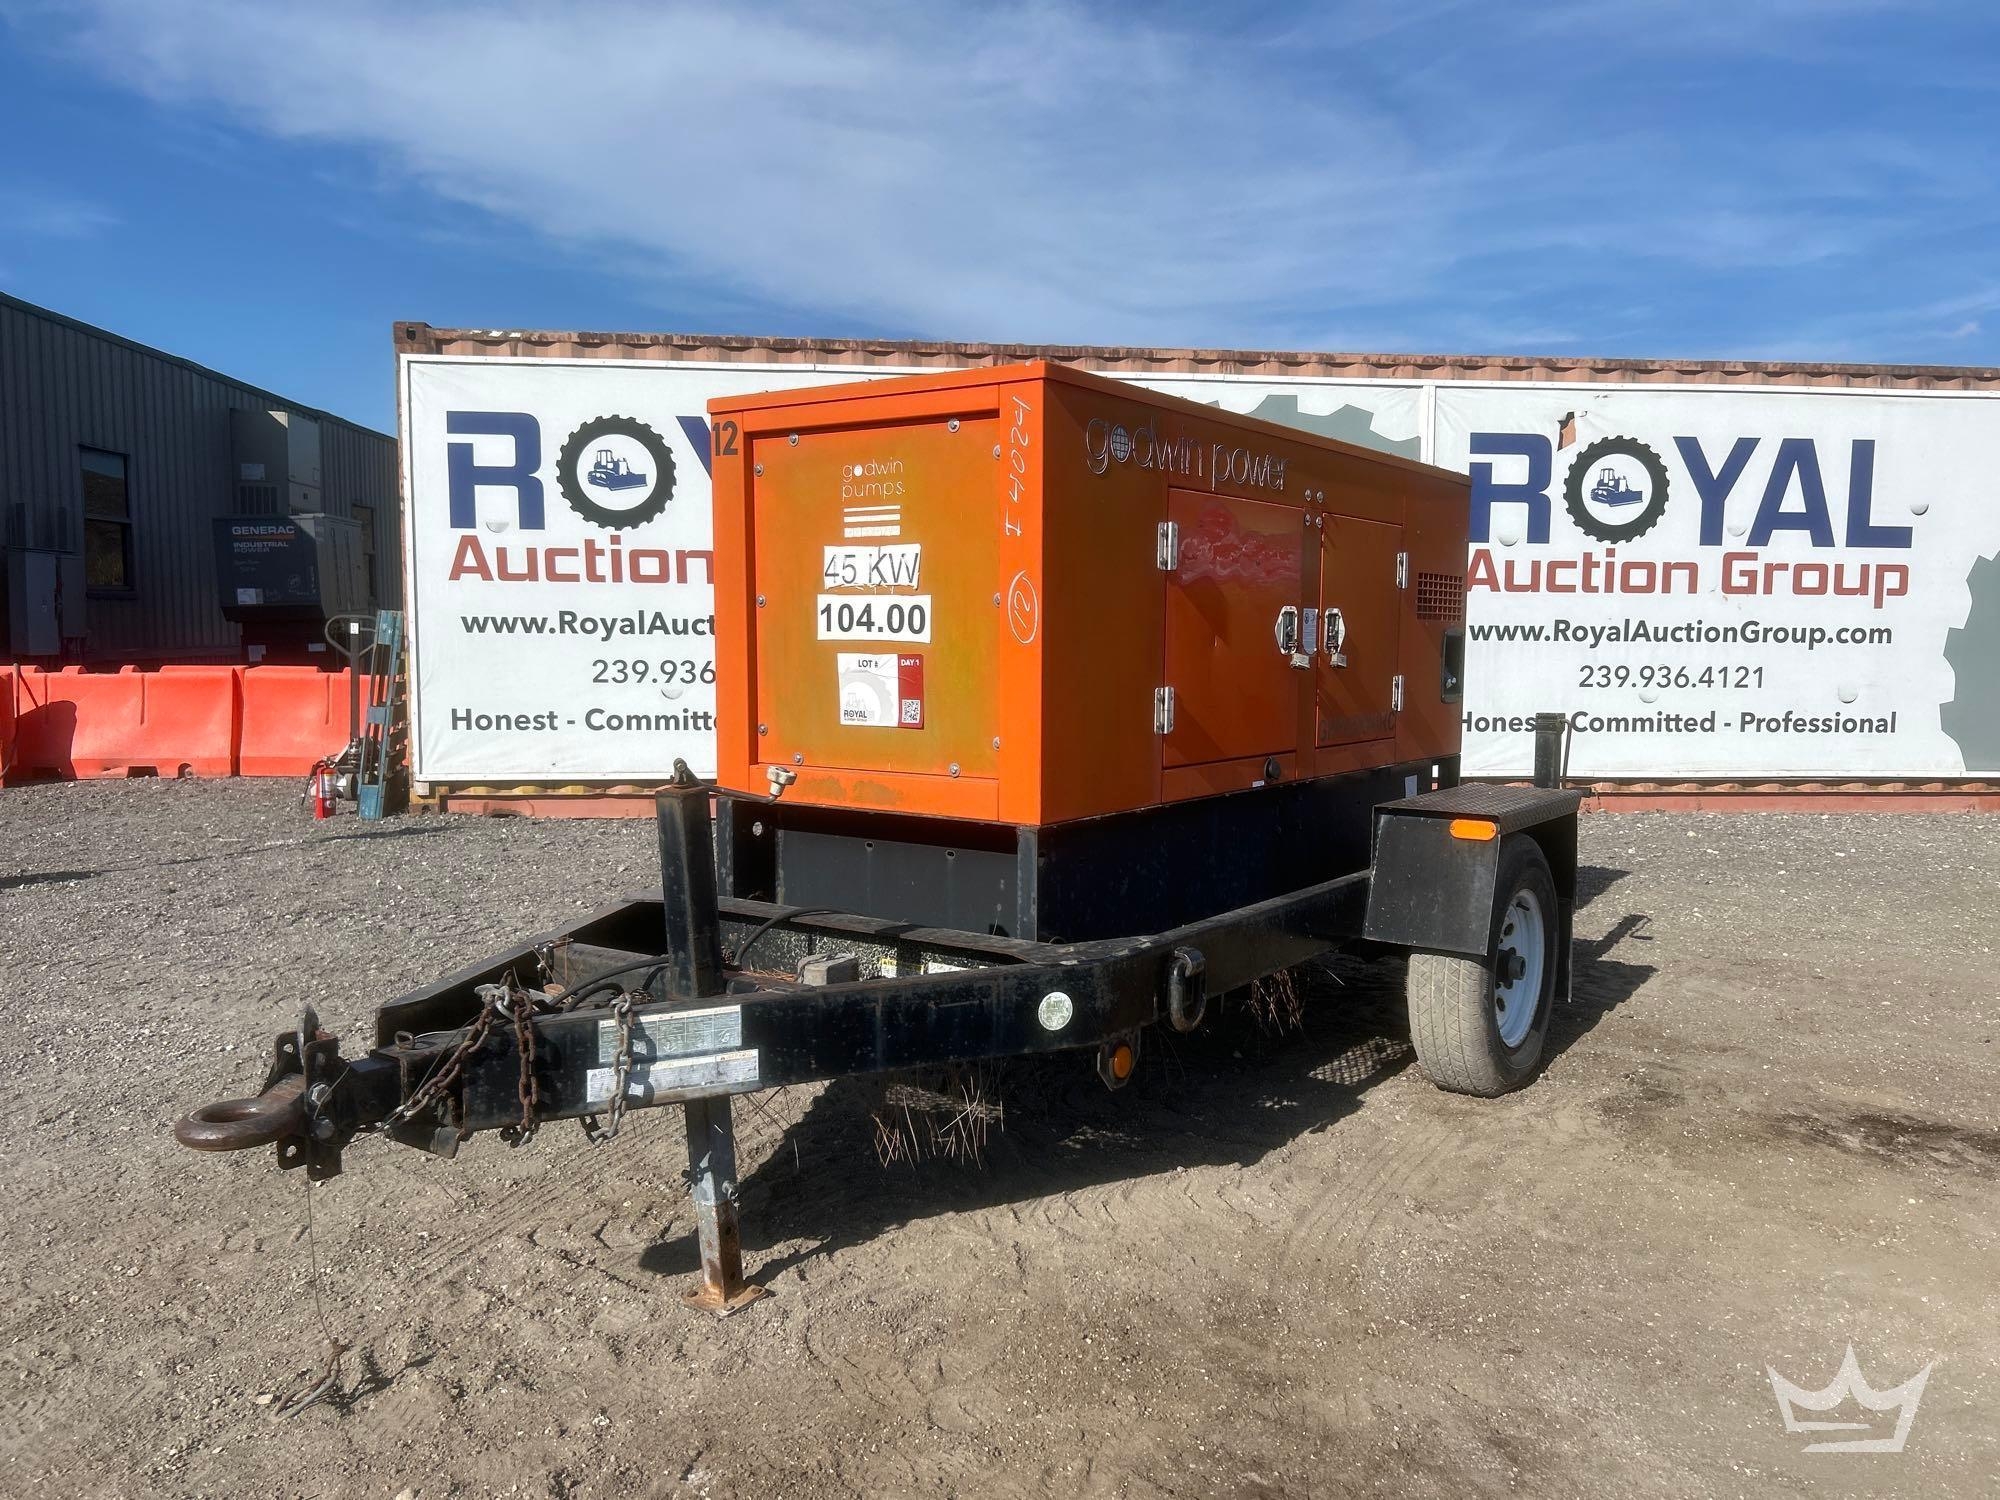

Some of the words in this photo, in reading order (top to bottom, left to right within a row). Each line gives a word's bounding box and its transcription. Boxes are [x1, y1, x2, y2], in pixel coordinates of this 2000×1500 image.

[712, 420, 739, 457] 12
[1211, 443, 1288, 491] power
[1469, 432, 1913, 548] ROYAL
[231, 525, 296, 535] GENERAC
[824, 554, 857, 585] 45
[1467, 548, 1699, 594] Auction
[1721, 552, 1909, 609] Group
[820, 603, 926, 635] 104.00
[1469, 619, 1893, 651] www.RoyalAuctionGroup.com
[857, 659, 873, 669] LOT
[900, 659, 914, 667] DAY
[1579, 664, 1764, 689] 239.936.4121
[451, 708, 558, 731] Honest
[584, 708, 717, 731] Committ
[1571, 710, 1716, 733] Committed
[1740, 710, 1897, 734] Professional
